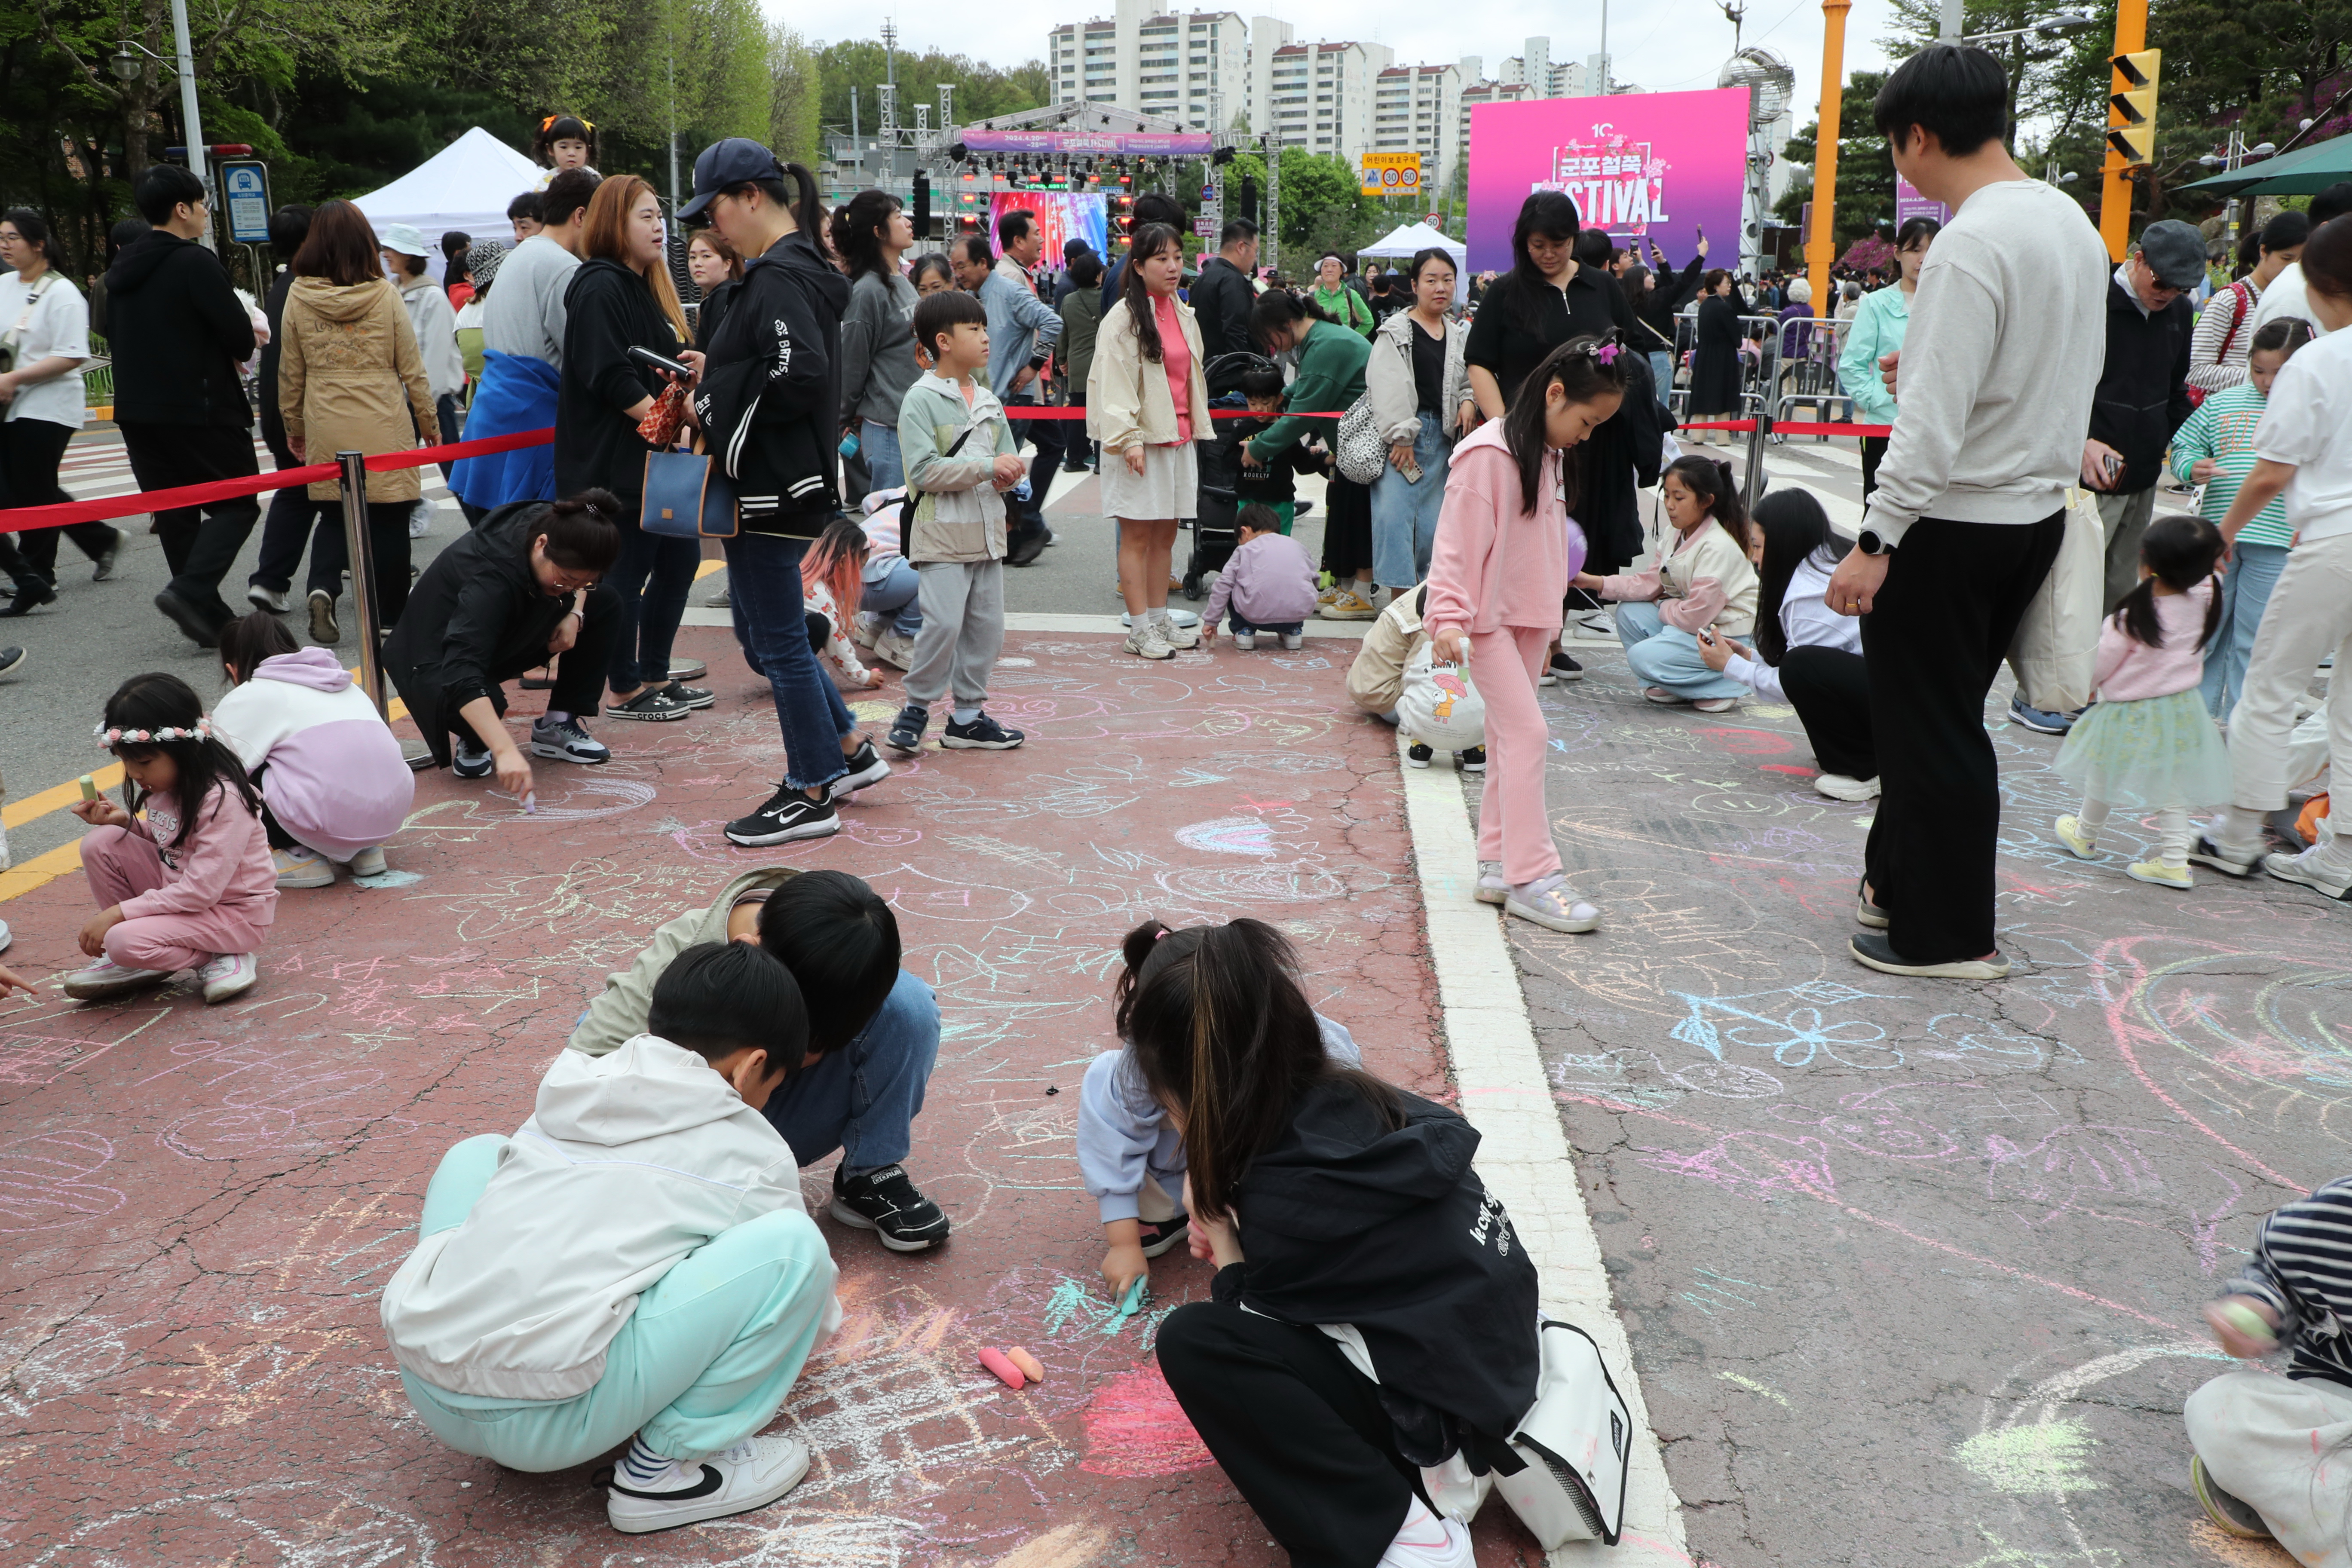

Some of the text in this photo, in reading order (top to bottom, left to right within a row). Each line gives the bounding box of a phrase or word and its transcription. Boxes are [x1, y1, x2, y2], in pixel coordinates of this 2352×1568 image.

[1091, 139, 1118, 148] FESTIVAL
[1560, 156, 1642, 176] 군포철쭉
[1386, 172, 1415, 181] 30 50
[166, 816, 178, 831] IS
